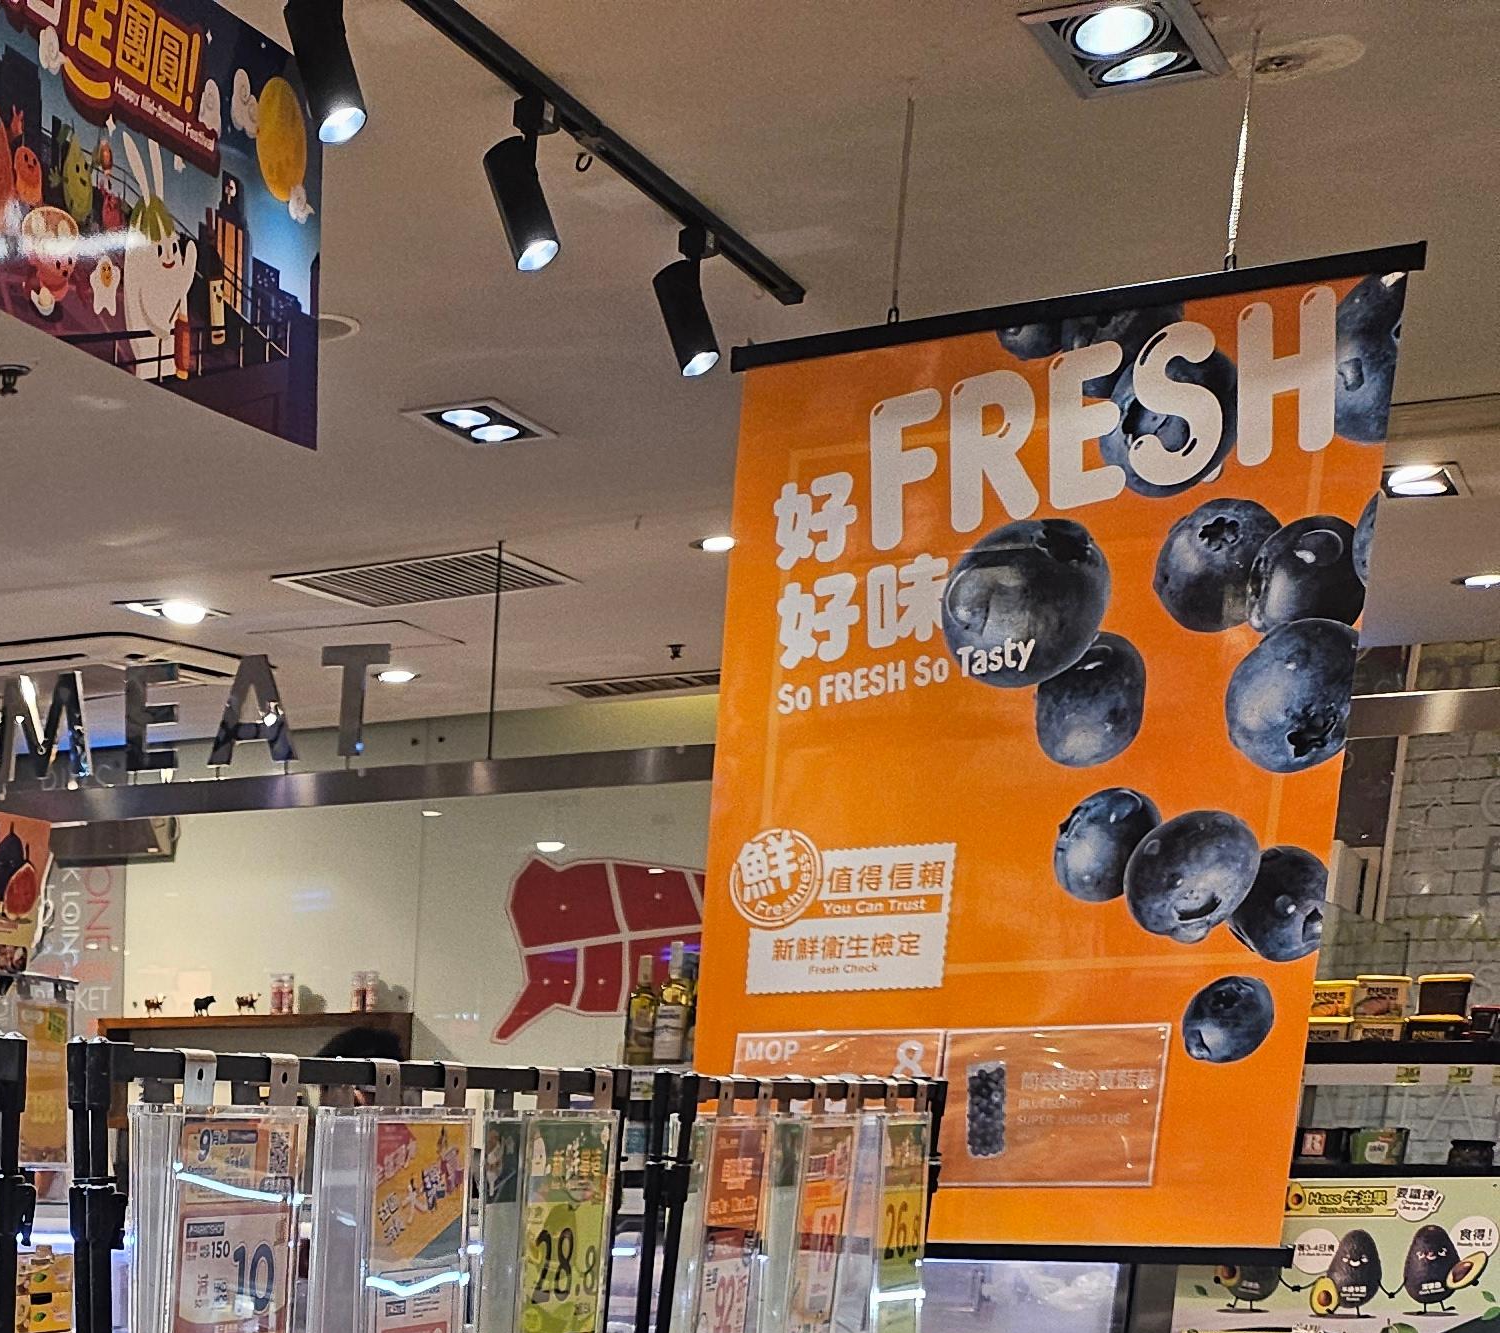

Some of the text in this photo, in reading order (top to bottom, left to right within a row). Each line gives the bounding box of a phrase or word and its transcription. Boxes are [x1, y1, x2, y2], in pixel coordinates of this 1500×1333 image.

[869, 285, 1338, 552] FRESH
[776, 554, 949, 669] 好味
[820, 660, 906, 707] FRESH
[957, 638, 1035, 678] Tasty
[0, 643, 391, 795] MEAT
[738, 831, 798, 902] 鮮
[755, 851, 812, 916] Freshness
[828, 860, 946, 894] 值得信賴
[822, 897, 927, 917] You Can Trust
[808, 962, 879, 976] Fresh Check
[745, 1039, 799, 1063] MOP
[1308, 1190, 1388, 1206] Hass 牛油果
[211, 1241, 230, 1259] 150
[233, 1241, 275, 1315] 10
[532, 1227, 597, 1304] 28.8
